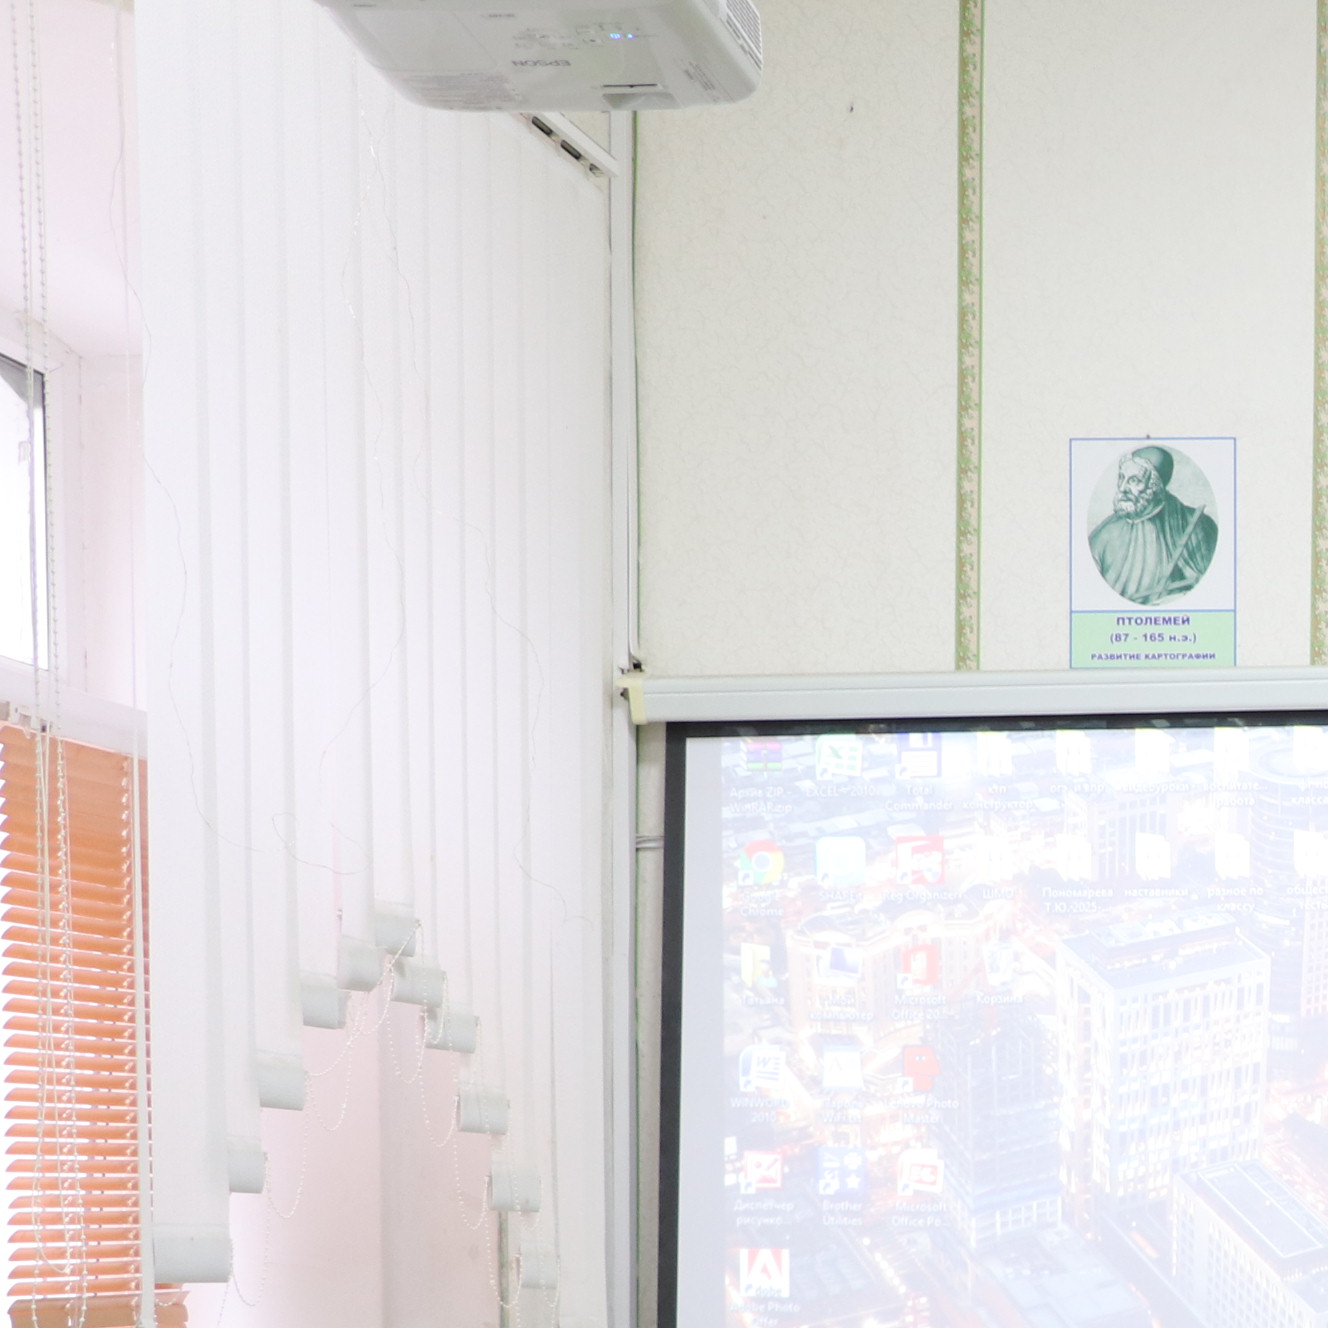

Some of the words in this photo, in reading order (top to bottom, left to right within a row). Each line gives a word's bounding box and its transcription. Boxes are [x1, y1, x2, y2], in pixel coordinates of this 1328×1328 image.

[1116, 614, 1190, 626] ПТОЛЕМЕЙ
[1110, 632, 1129, 644] (87
[1142, 633, 1164, 643] 165
[1145, 652, 1216, 660] КАРТОГРАФИИ
[823, 1200, 862, 1210] Brother
[896, 1200, 947, 1211] Microsoft
